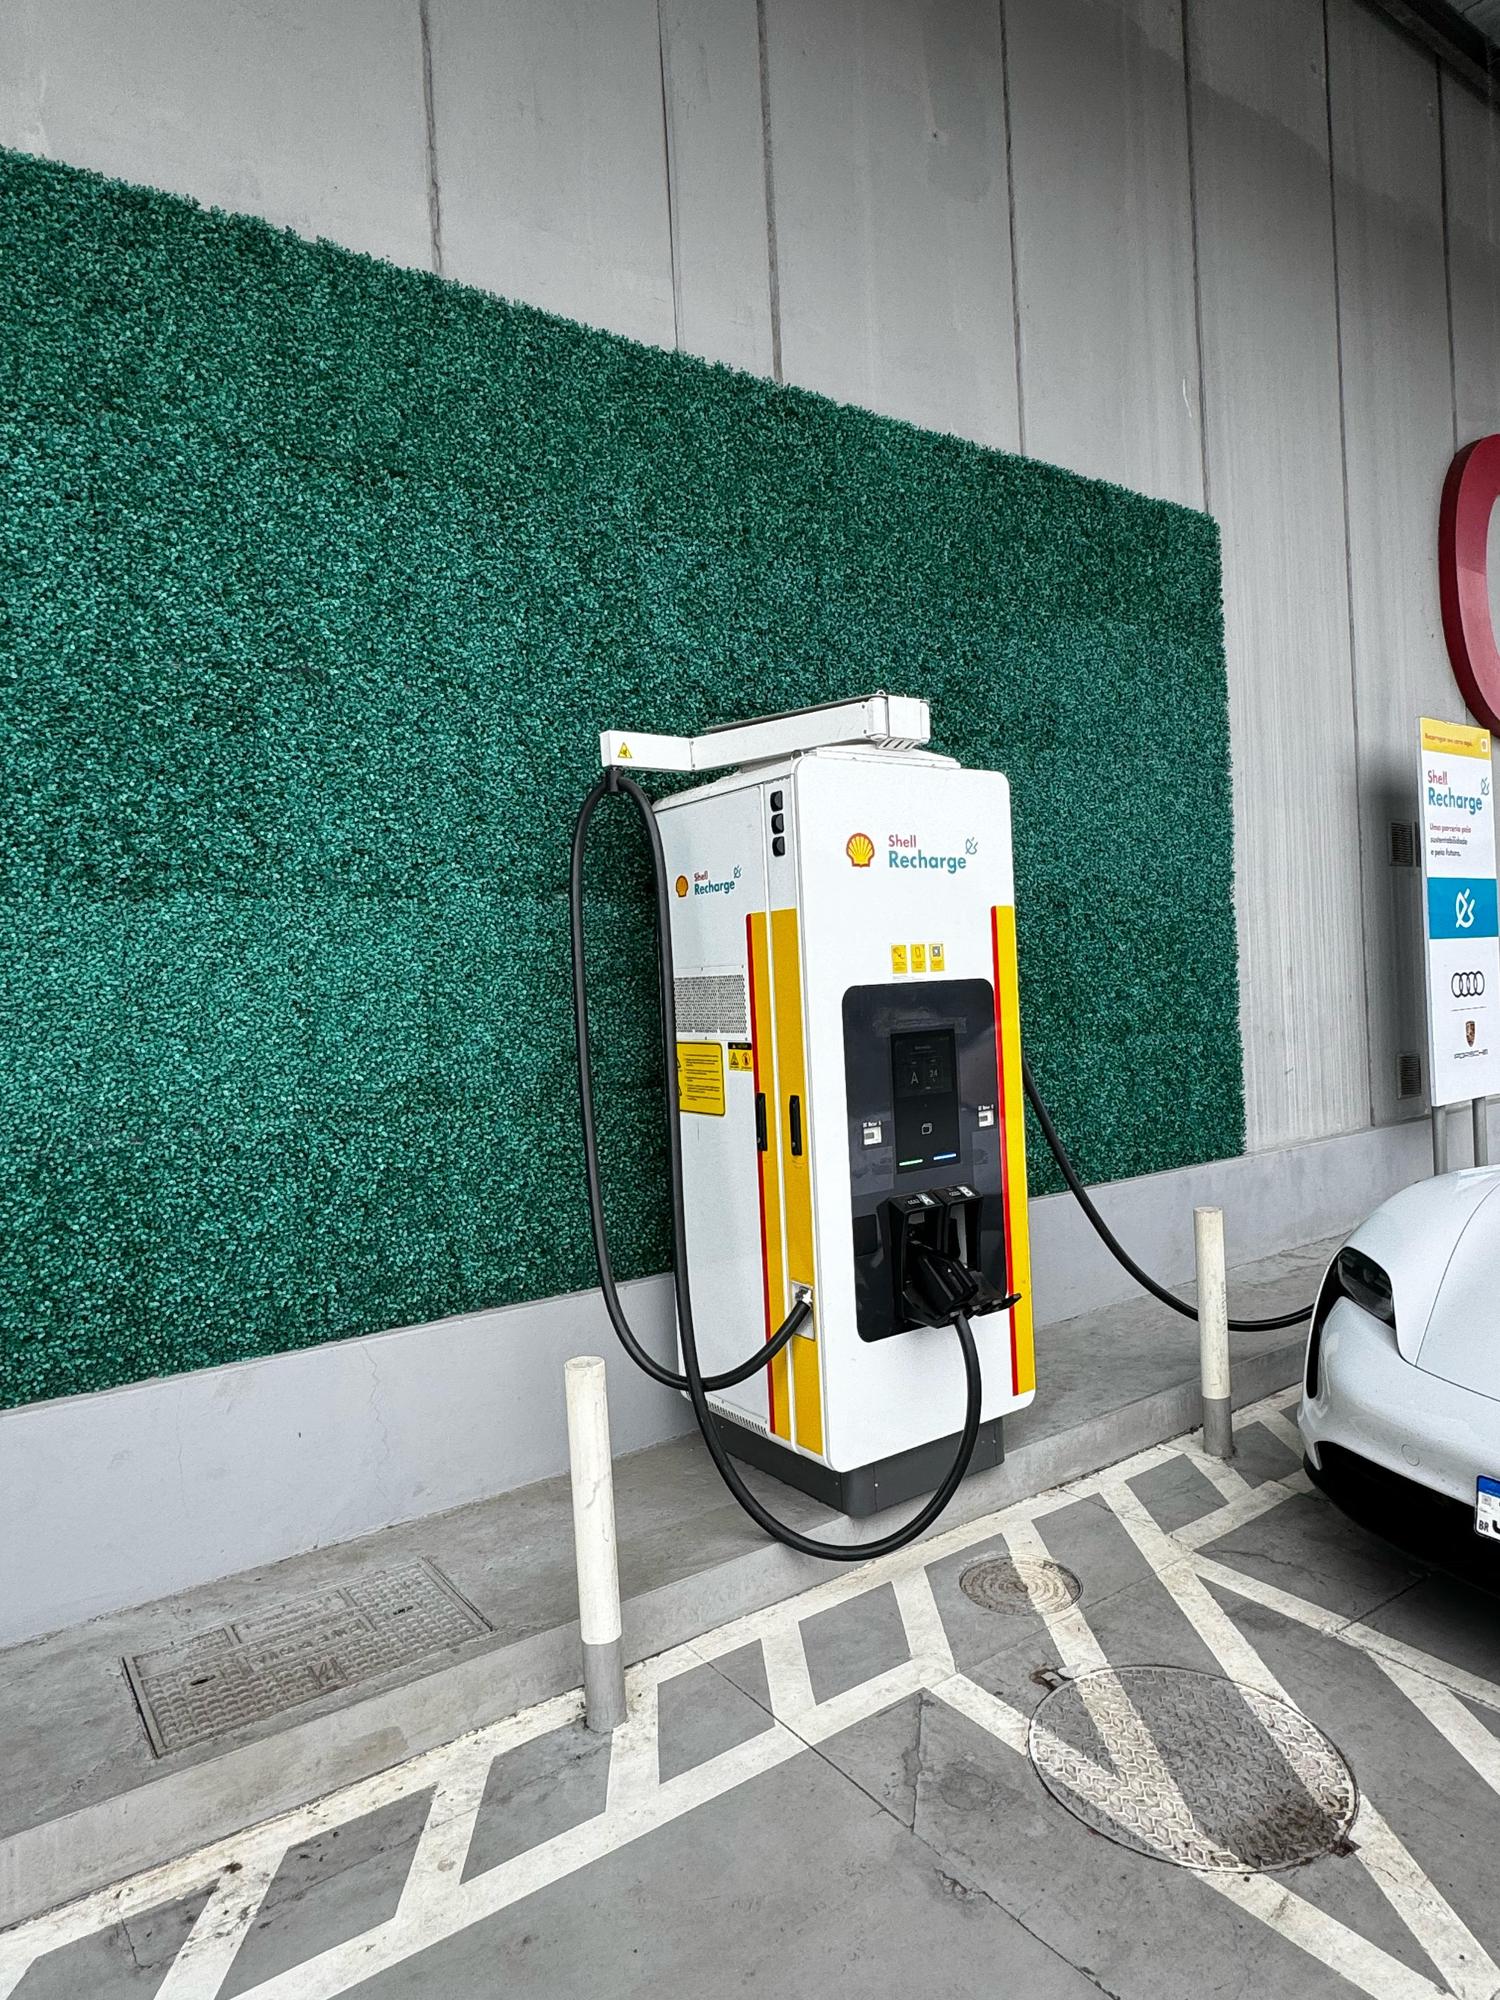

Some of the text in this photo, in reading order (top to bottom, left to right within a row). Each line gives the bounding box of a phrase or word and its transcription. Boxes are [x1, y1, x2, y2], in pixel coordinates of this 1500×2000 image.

[1427, 769, 1448, 785] Shell
[1428, 787, 1482, 815] Recharge
[888, 834, 917, 848] Shell
[888, 849, 967, 874] Recharge
[694, 870, 708, 882] Shell
[694, 880, 735, 895] Recharge
[957, 1186, 976, 1198] B
[916, 1193, 935, 1206] A
[1478, 1520, 1489, 1532] BR
